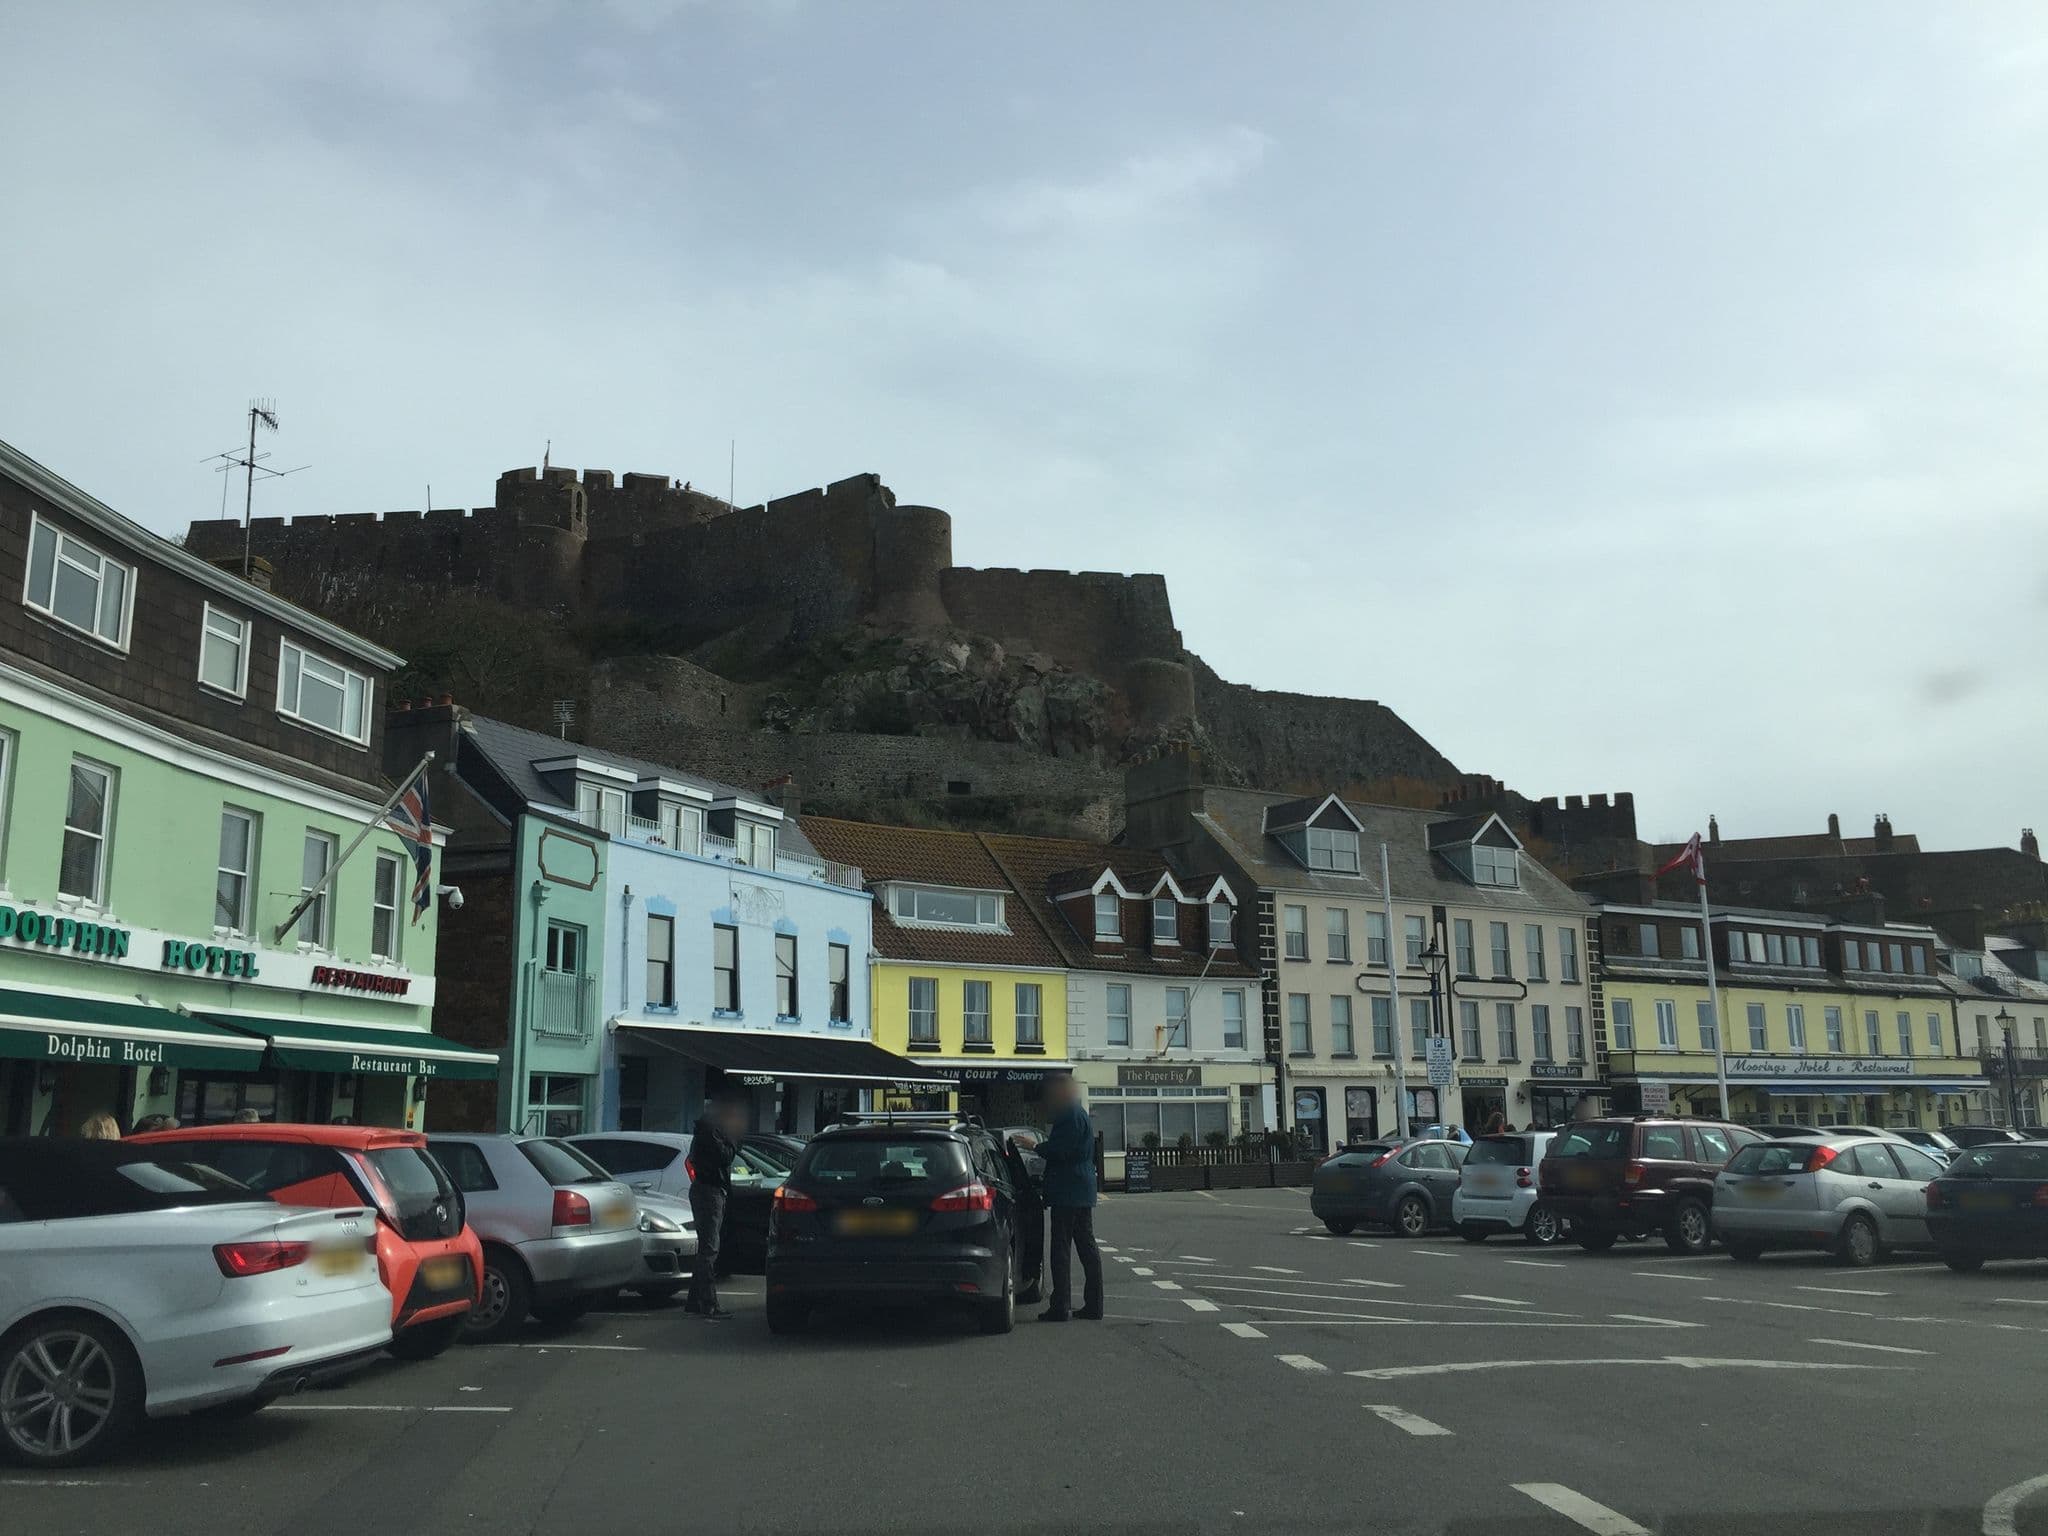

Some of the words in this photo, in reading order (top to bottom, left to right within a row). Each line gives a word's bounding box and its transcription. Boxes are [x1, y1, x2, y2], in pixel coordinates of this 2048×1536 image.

[0, 905, 131, 958] DOLPHIN
[163, 939, 260, 978] HOTEL
[312, 965, 412, 996] RESTAURANT
[48, 1034, 111, 1062] Dolphin
[123, 1041, 163, 1063] Hotel
[352, 1055, 412, 1073] Restaurant
[419, 1059, 437, 1075] Bar
[965, 1070, 999, 1080] COURT
[1730, 1058, 1786, 1075] Moorings
[1794, 1058, 1832, 1074] Hotel
[1851, 1060, 1911, 1075] Restaurant
[1127, 1070, 1143, 1081] The
[1144, 1070, 1168, 1083] Paper
[1170, 1070, 1184, 1083] Fig
